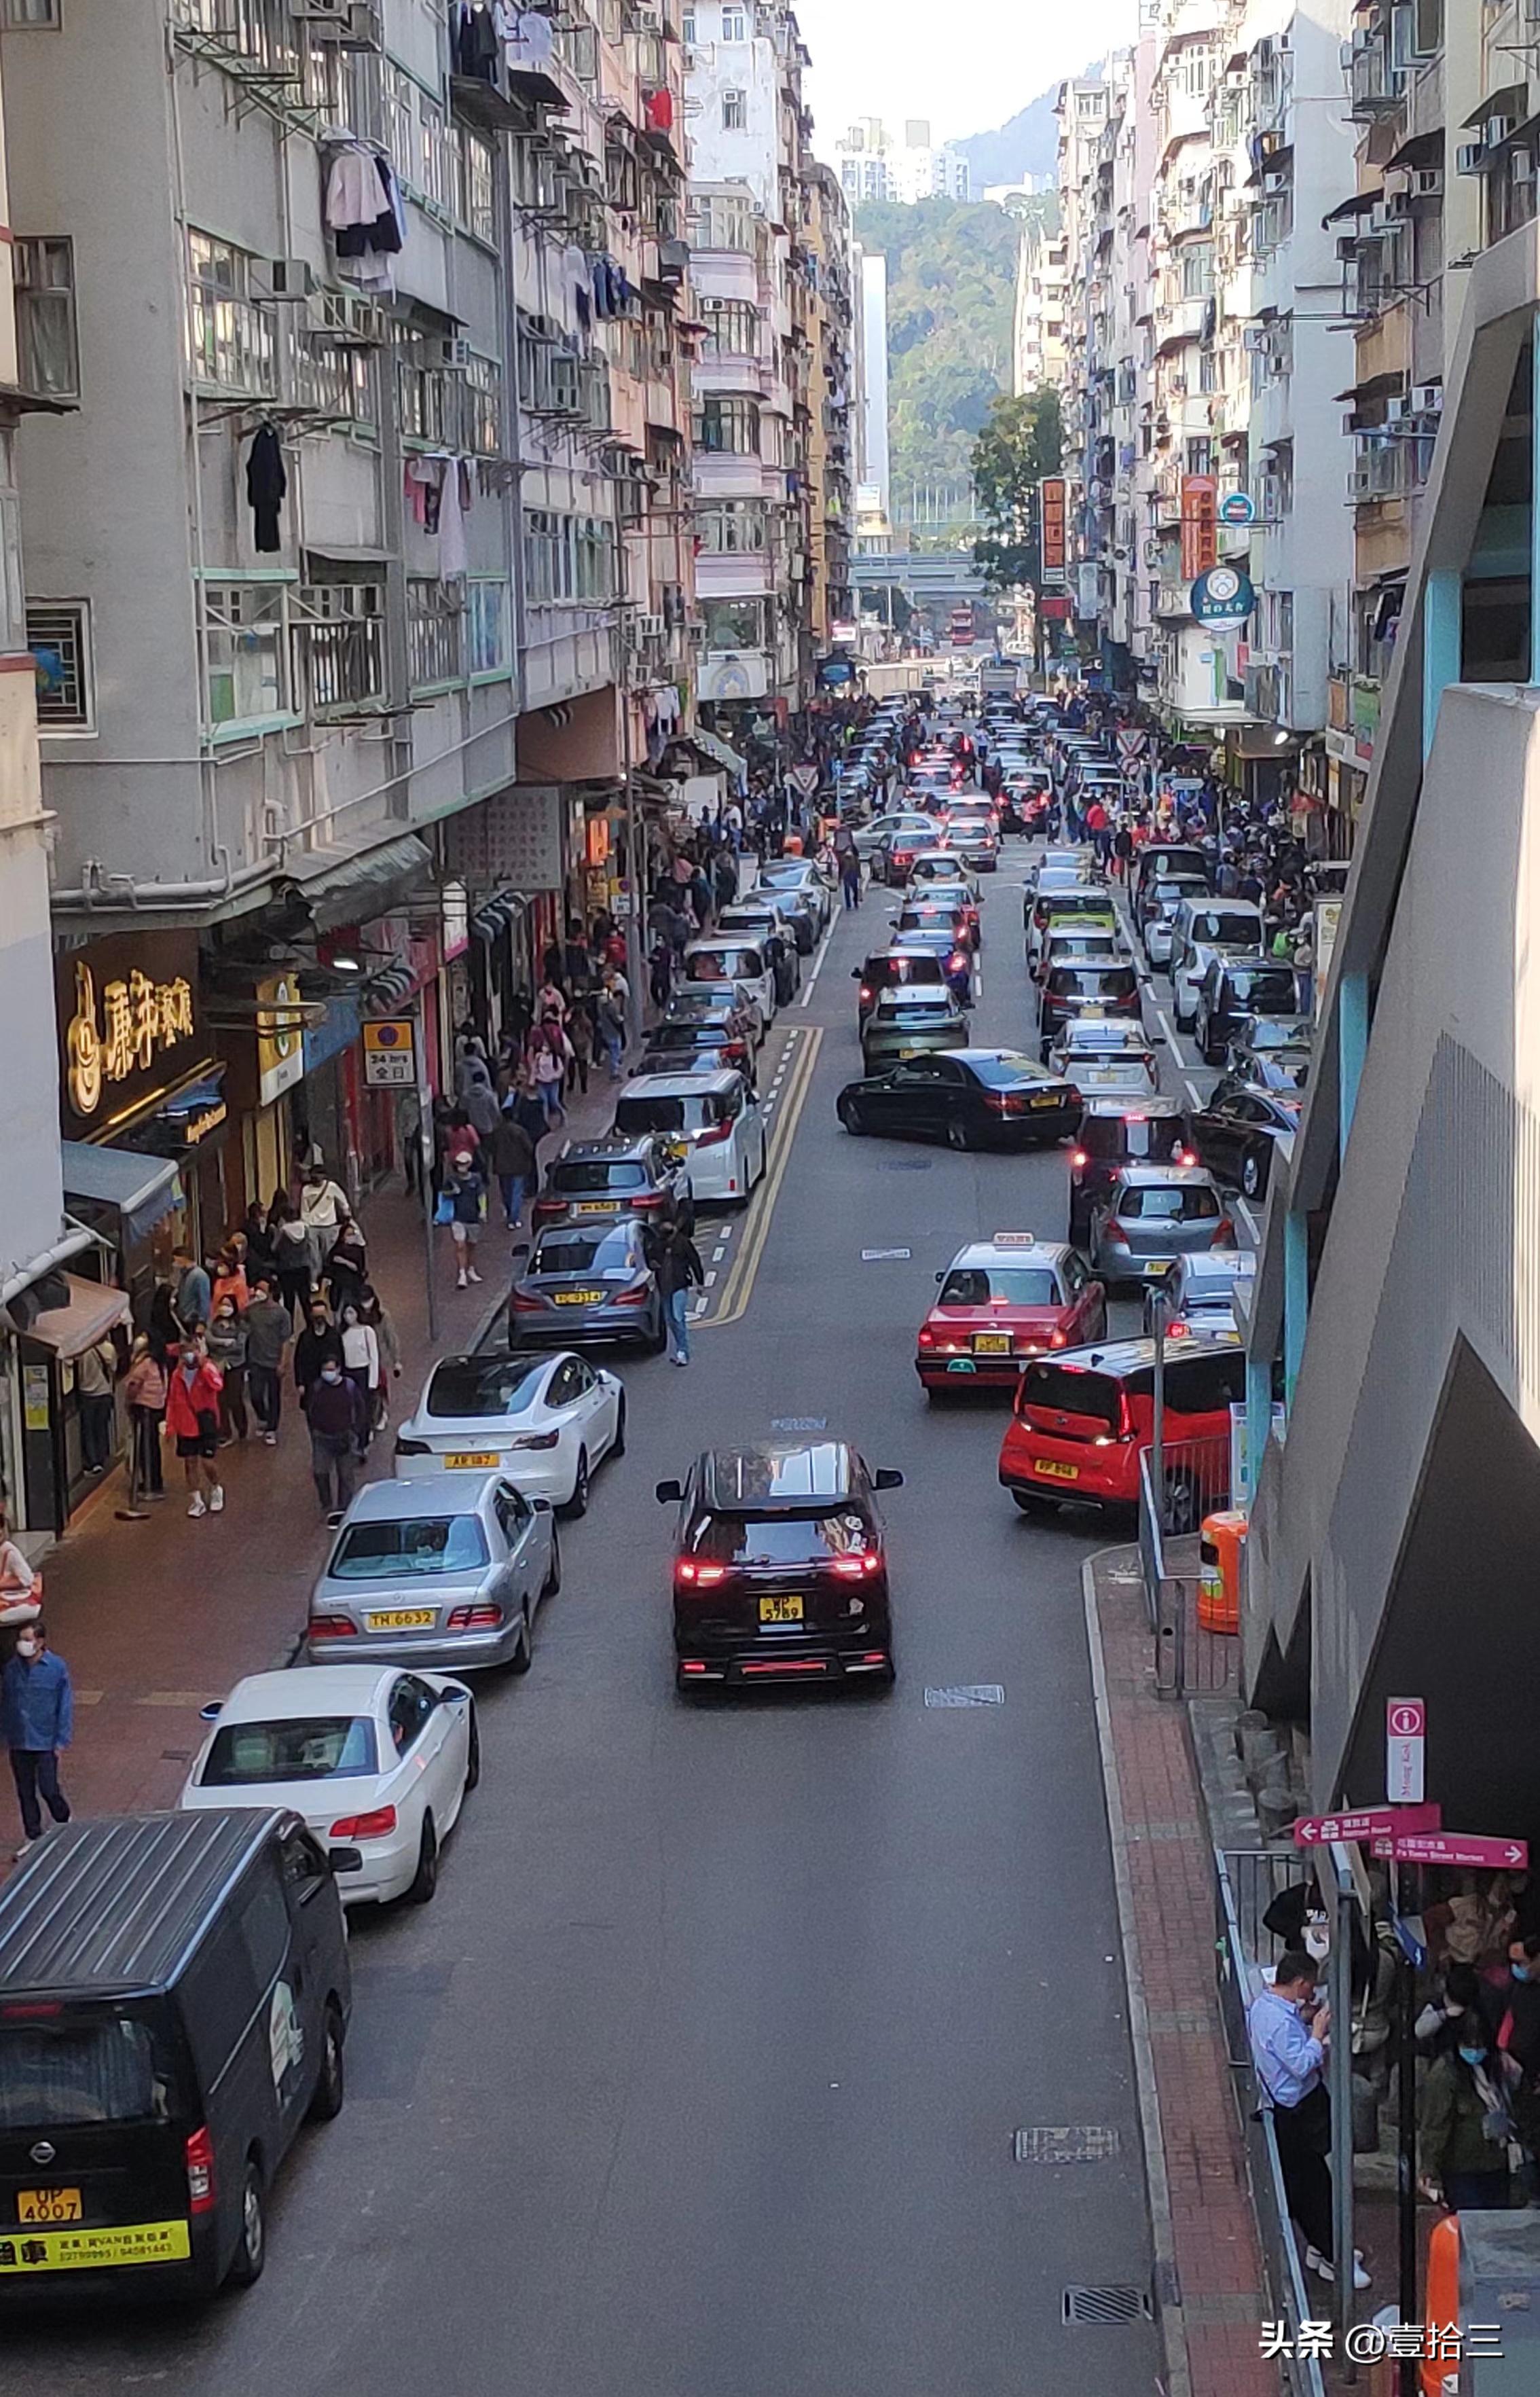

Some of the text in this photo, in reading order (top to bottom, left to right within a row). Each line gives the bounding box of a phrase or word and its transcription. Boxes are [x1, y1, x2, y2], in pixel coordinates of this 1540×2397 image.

[371, 1055, 386, 1064] 24
[376, 1067, 404, 1079] 全日
[373, 1615, 390, 1626] TH
[25, 2203, 77, 2220] 4007
